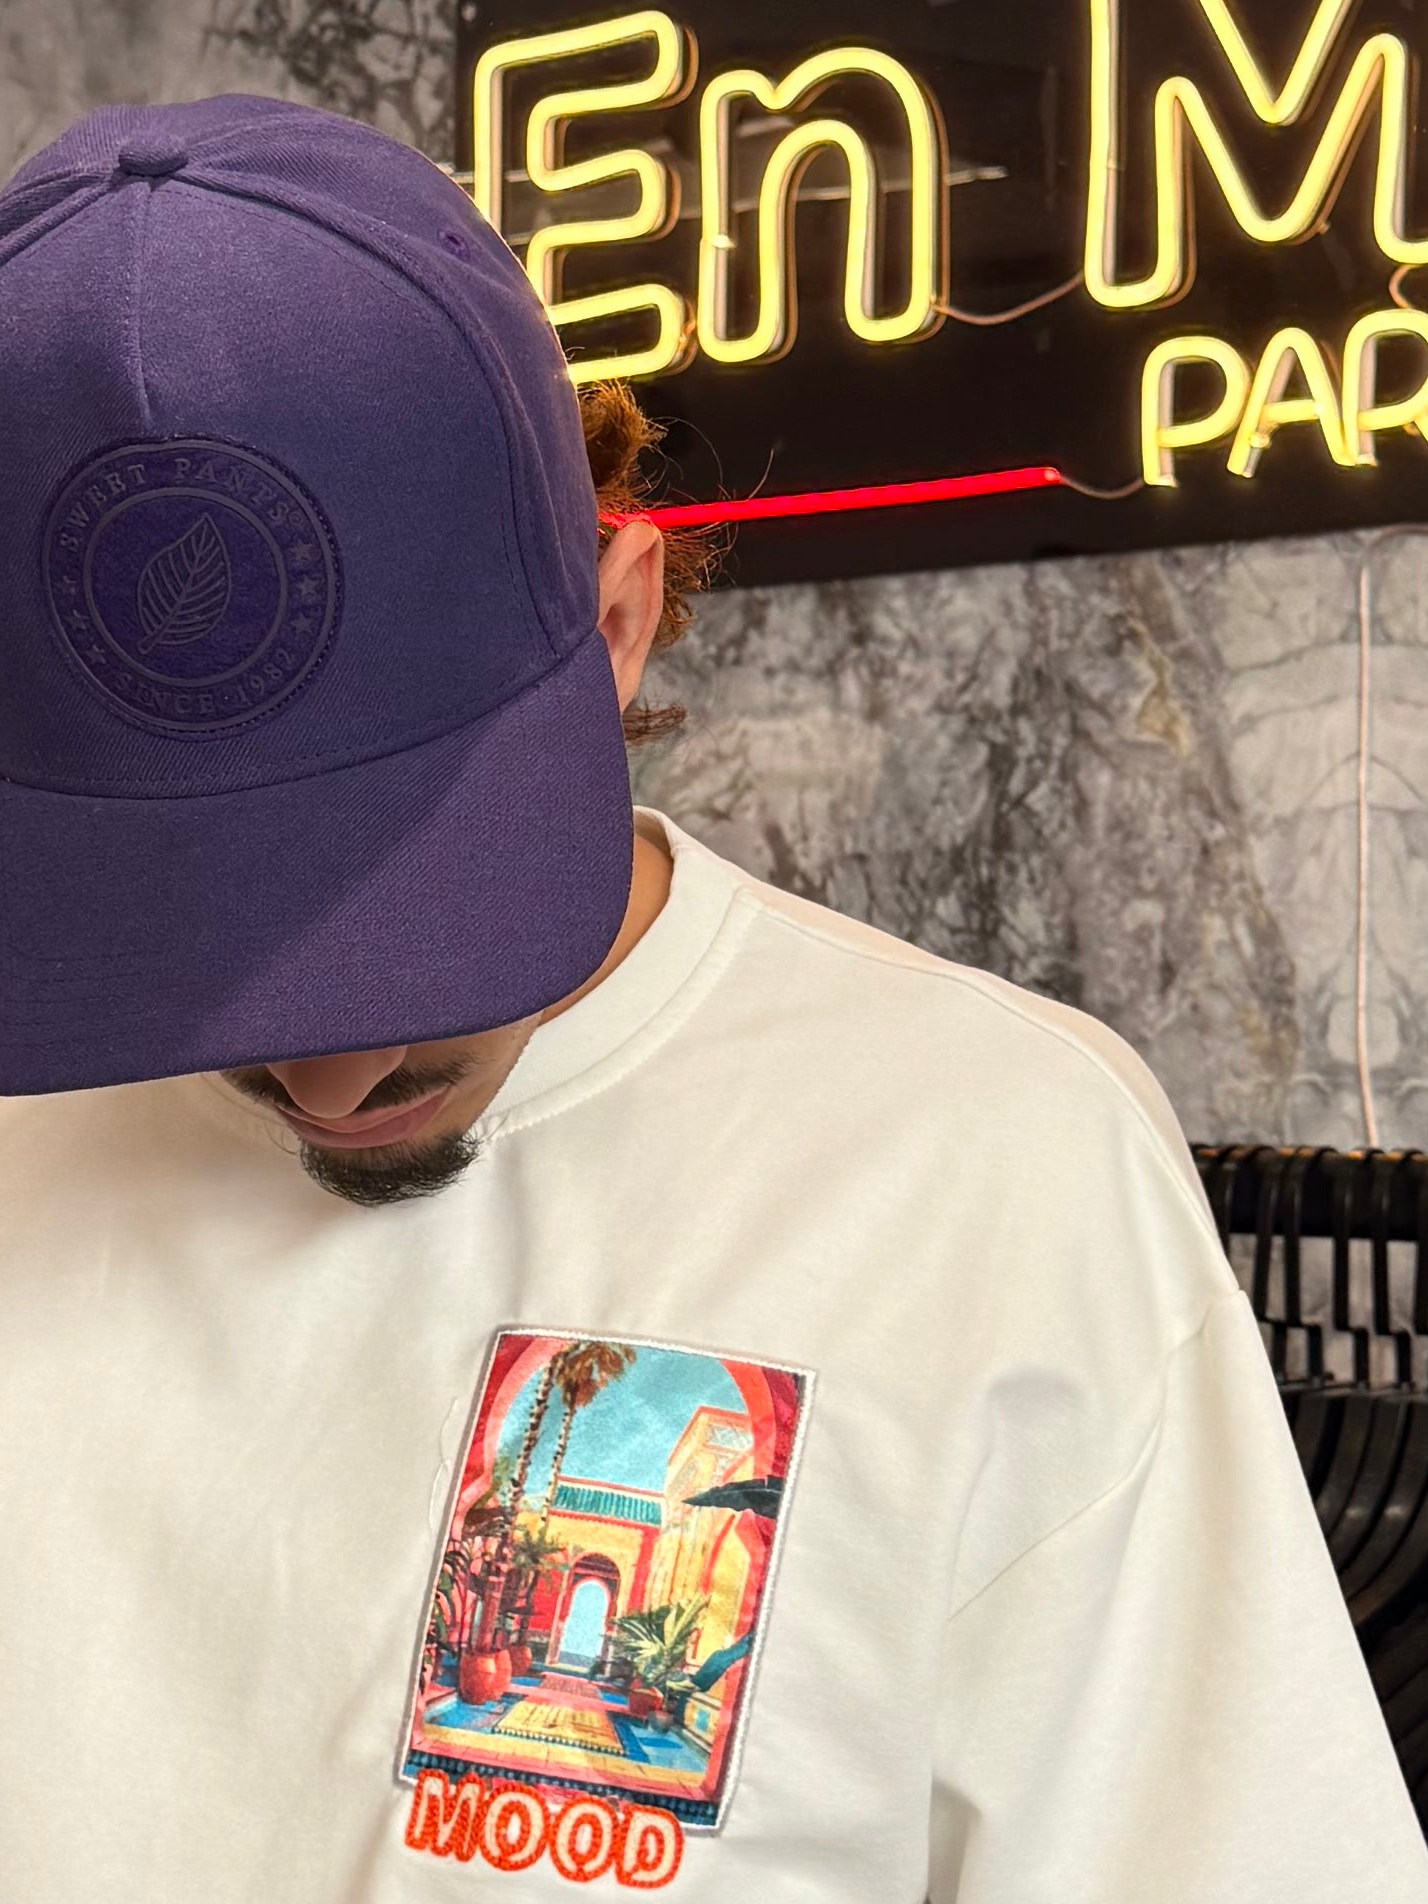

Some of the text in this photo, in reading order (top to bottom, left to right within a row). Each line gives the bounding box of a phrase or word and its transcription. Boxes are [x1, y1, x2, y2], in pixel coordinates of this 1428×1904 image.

[473, 10, 941, 385] En
[58, 463, 146, 553] SWEET
[235, 647, 297, 703] 1982
[404, 1768, 685, 1889] MOOD
